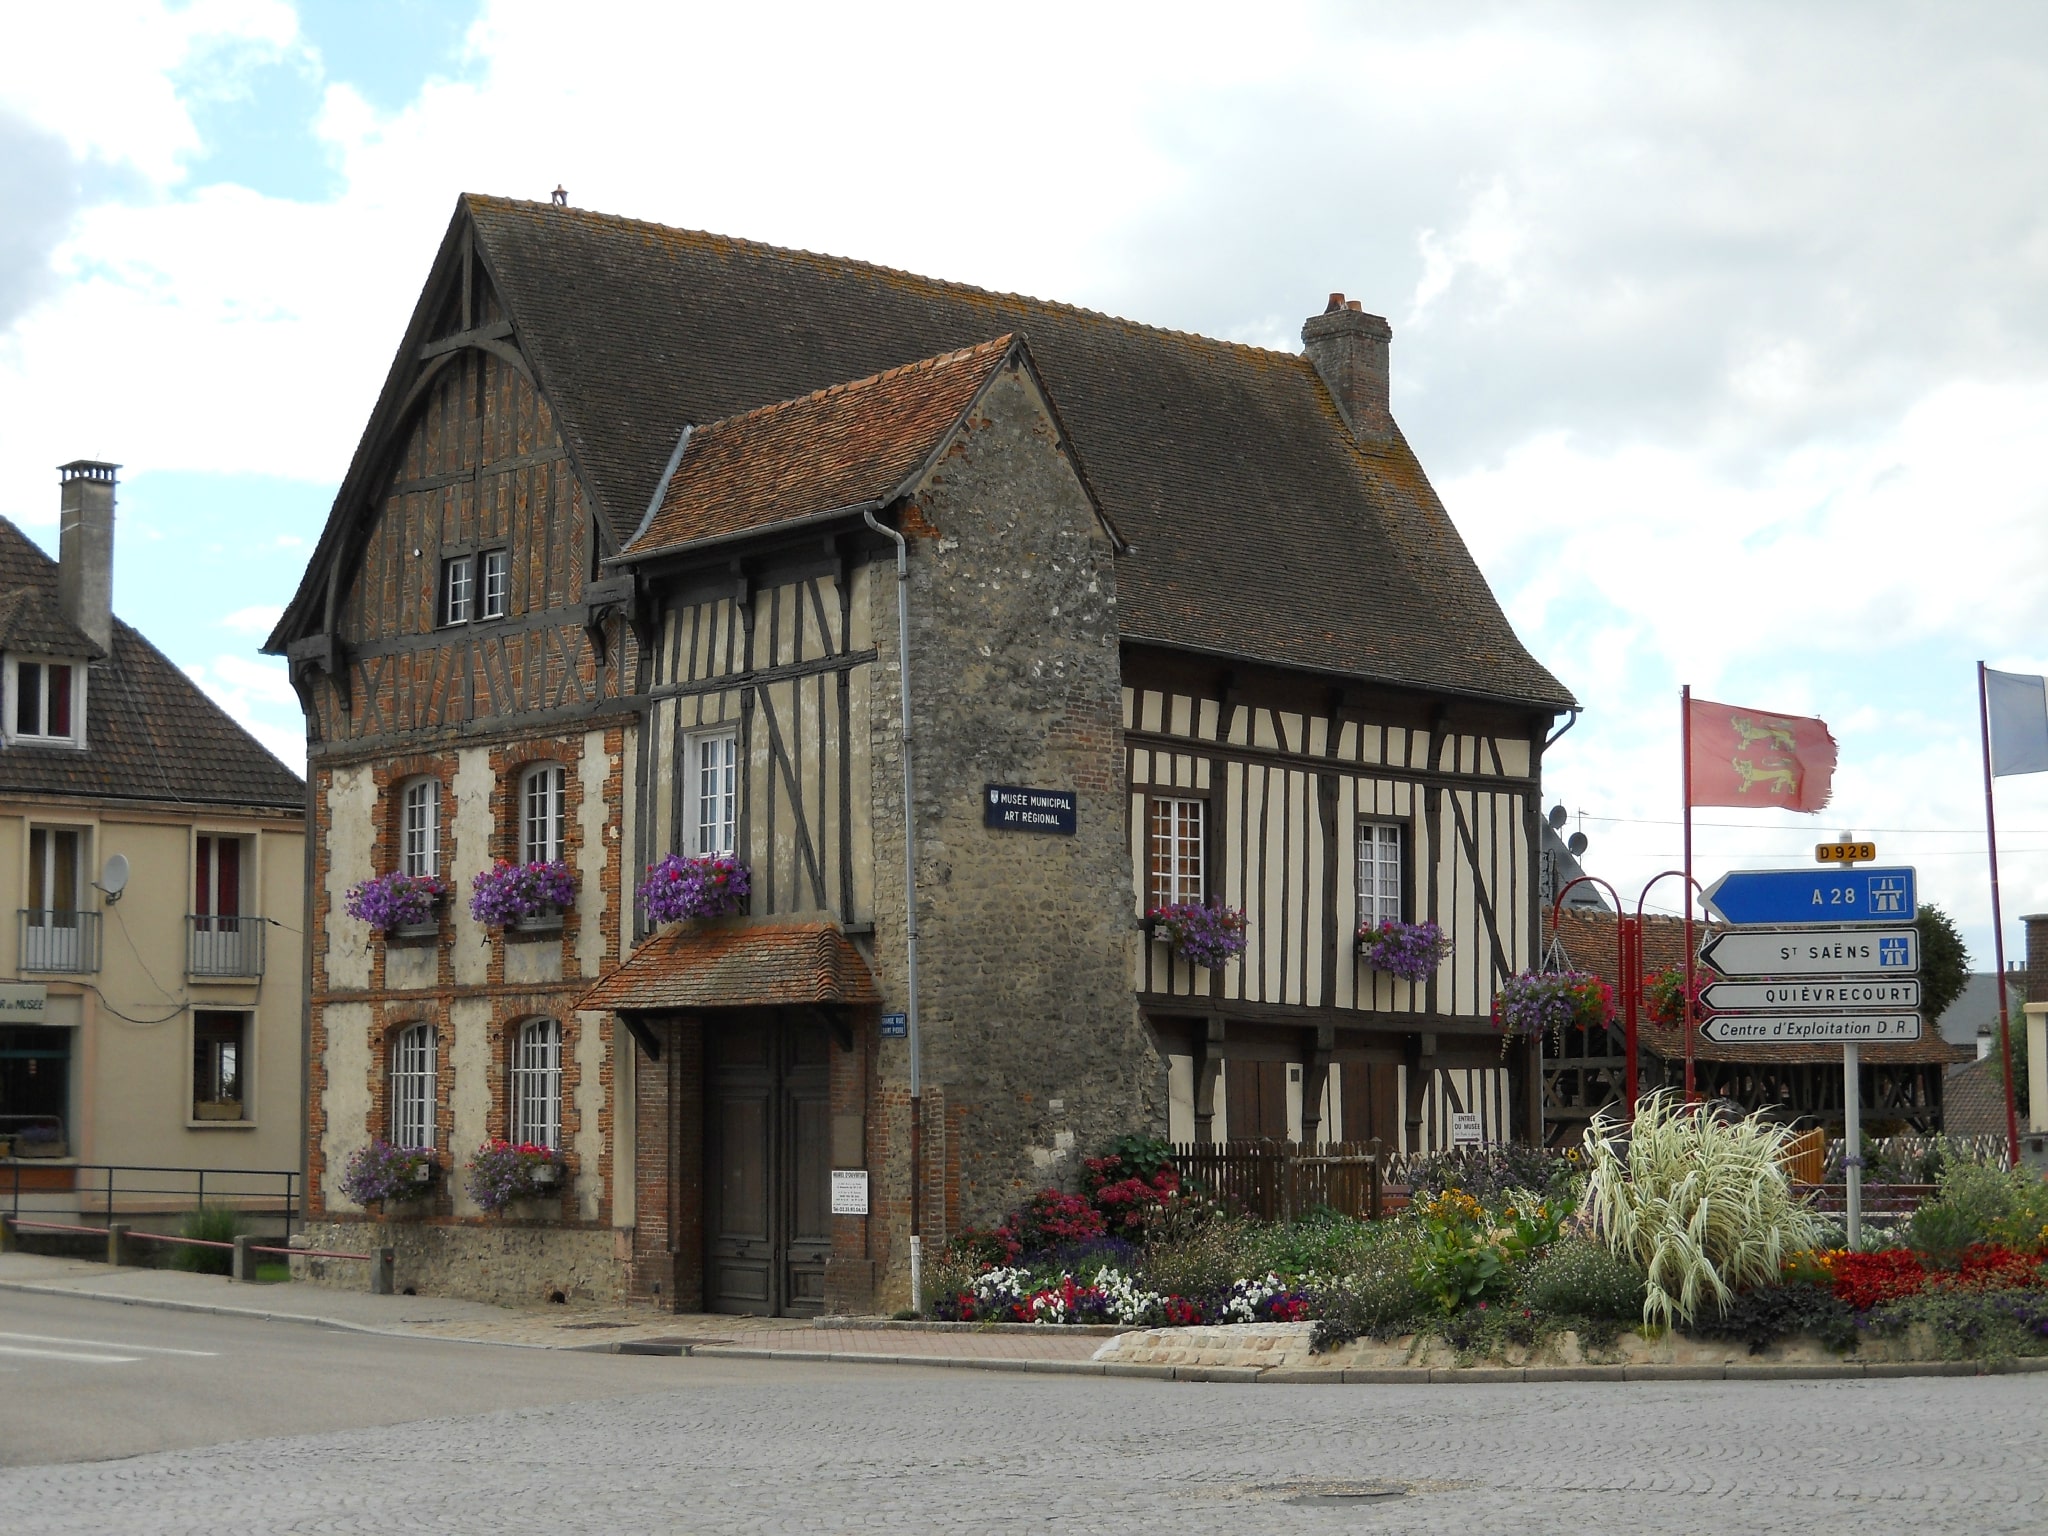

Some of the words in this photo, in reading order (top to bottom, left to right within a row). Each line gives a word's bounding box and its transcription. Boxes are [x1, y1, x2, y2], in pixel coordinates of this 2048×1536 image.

[1001, 793, 1028, 806] MUSÉE
[1030, 796, 1071, 810] MUNICIPAL
[1004, 811, 1020, 822] ART
[1022, 811, 1060, 825] RÉGIONAL
[1820, 846, 1829, 859] D
[1835, 845, 1869, 859] 928
[1812, 889, 1823, 905] A
[1831, 887, 1855, 904] 28
[1809, 943, 1870, 959] SAËNS
[1766, 986, 1911, 1003] QUIÈVRECOURT
[1720, 1023, 1767, 1036] Centre
[1773, 1021, 1870, 1037] d'Exploitation
